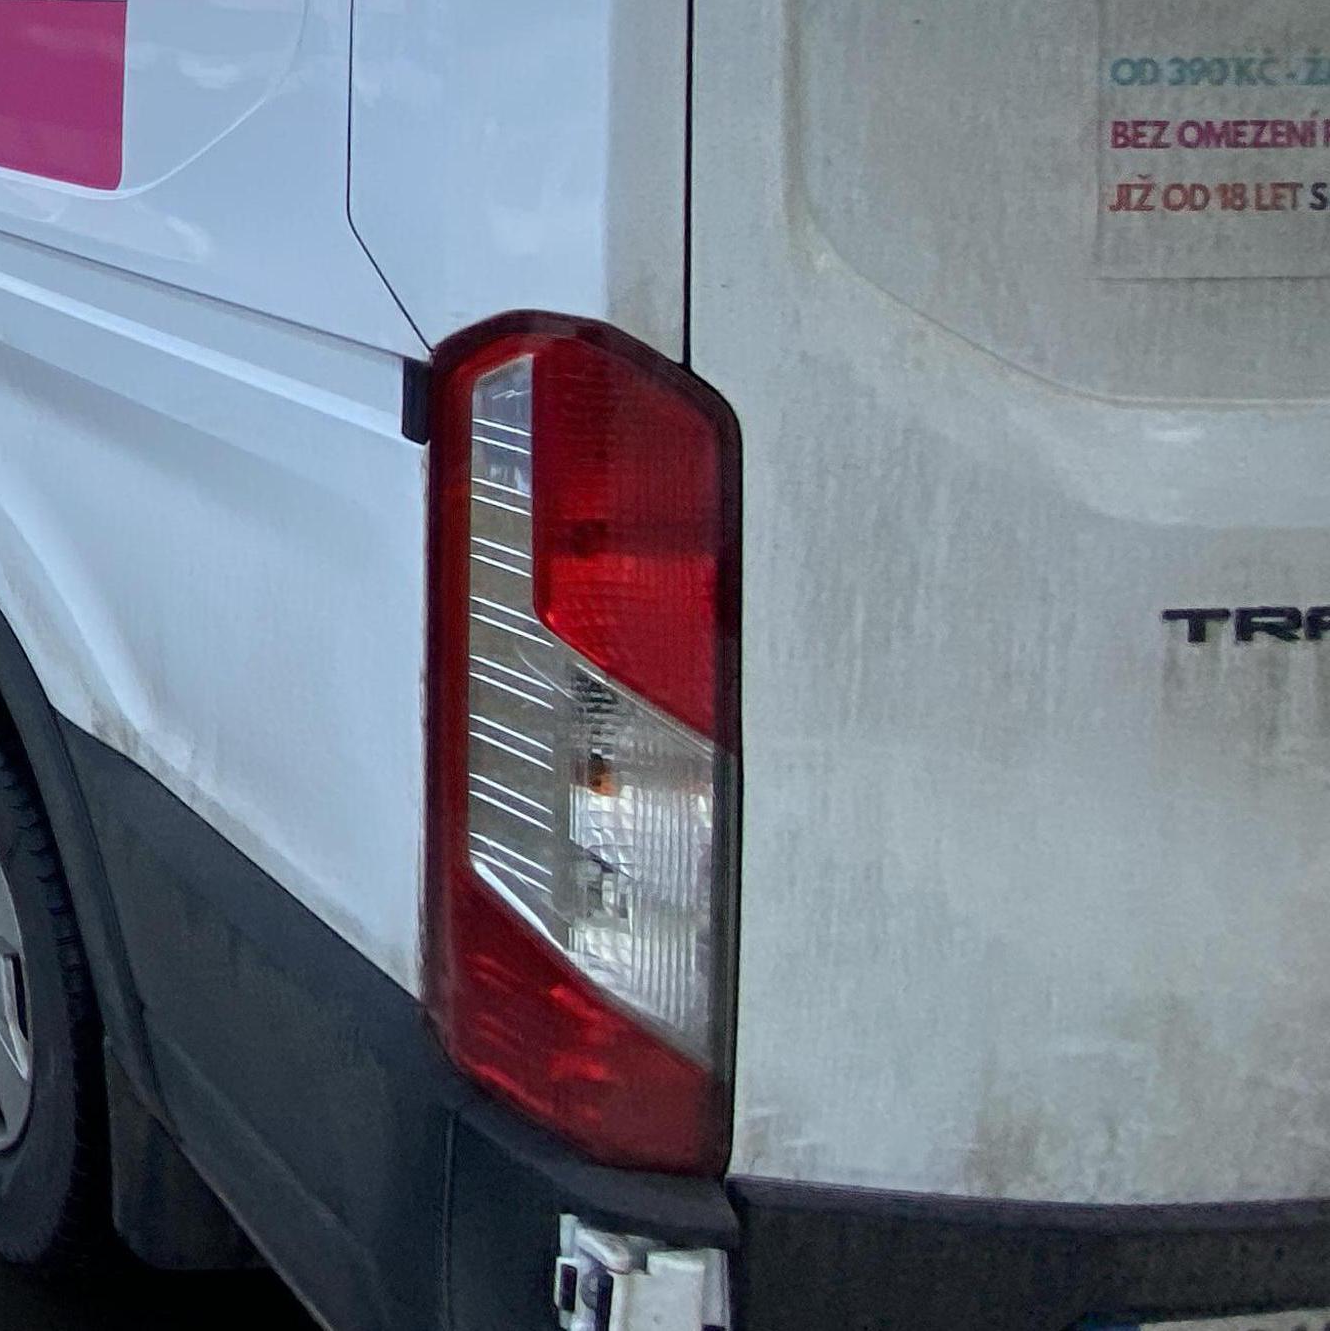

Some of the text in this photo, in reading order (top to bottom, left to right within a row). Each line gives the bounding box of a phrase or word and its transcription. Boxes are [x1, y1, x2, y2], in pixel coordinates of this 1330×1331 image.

[1110, 56, 1160, 87] OD
[1167, 56, 1229, 87] 390
[1110, 119, 1171, 149] BEZ
[1177, 110, 1317, 149] OMEZENÍ
[1109, 173, 1156, 212] JIŽ
[1161, 181, 1211, 212] OD
[1215, 181, 1248, 212] 18
[1253, 181, 1304, 212] LET
